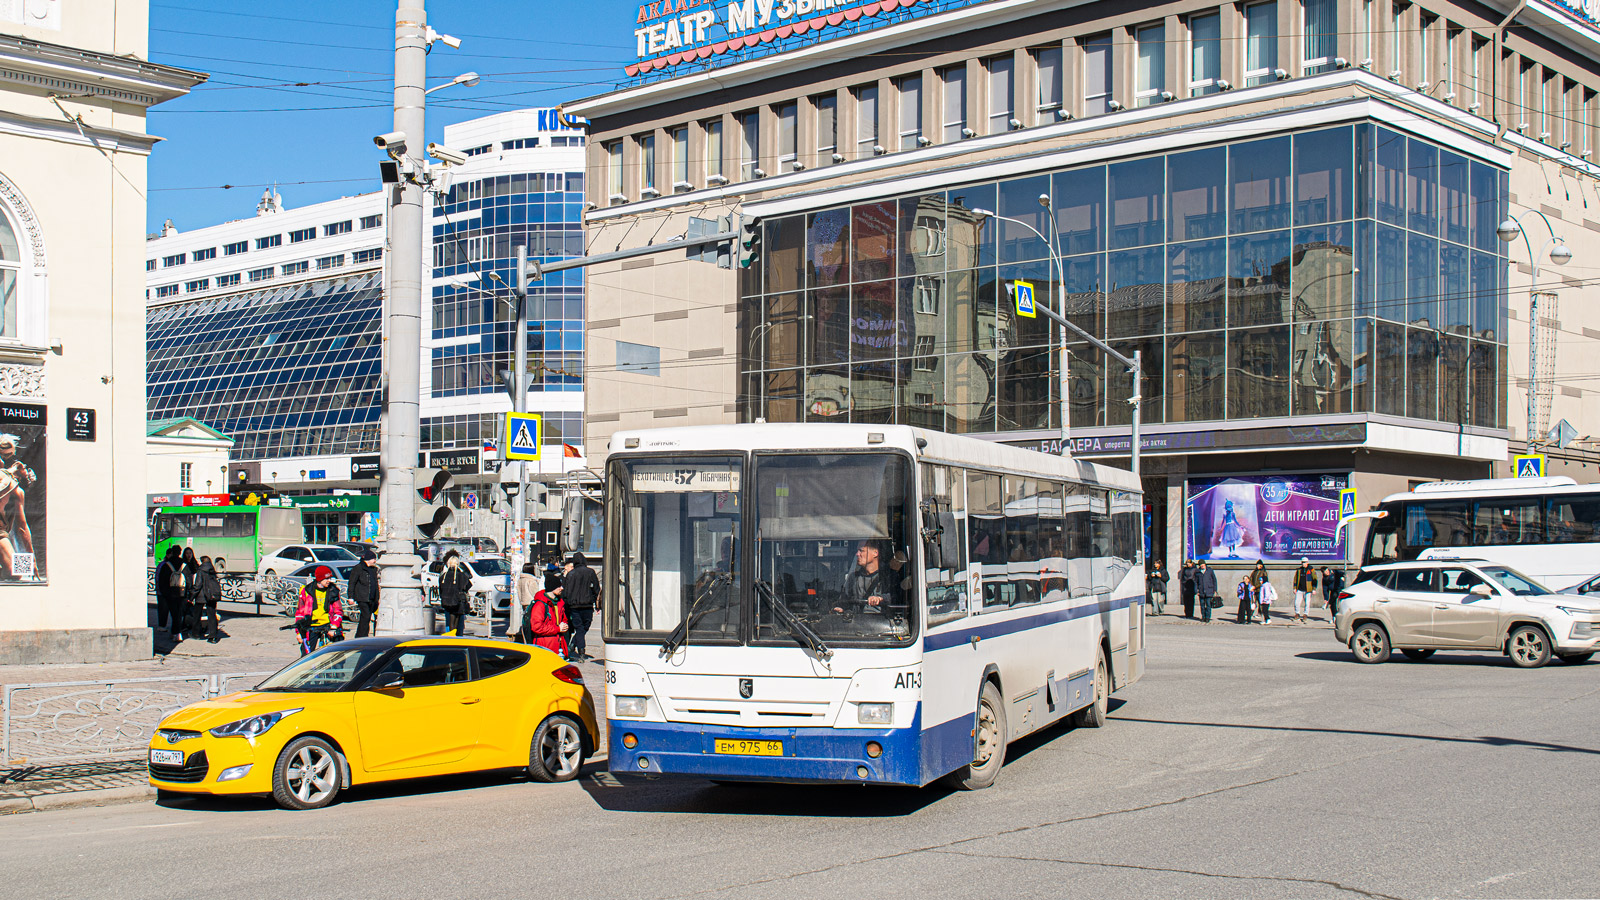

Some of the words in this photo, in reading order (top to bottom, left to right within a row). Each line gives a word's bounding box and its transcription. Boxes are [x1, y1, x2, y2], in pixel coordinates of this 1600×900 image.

[634, 10, 715, 58] ТЕАТР
[2, 407, 39, 419] ТАНЦЫ
[74, 412, 89, 424] 43
[674, 469, 697, 485] 57
[1265, 485, 1276, 498] 35
[1264, 510, 1285, 522] ДЕТИ
[1287, 509, 1320, 522] ИГРАЮТ
[1265, 541, 1273, 550] 30
[721, 743, 735, 752] ЕМ
[739, 741, 761, 753] 975
[767, 741, 779, 751] 66
